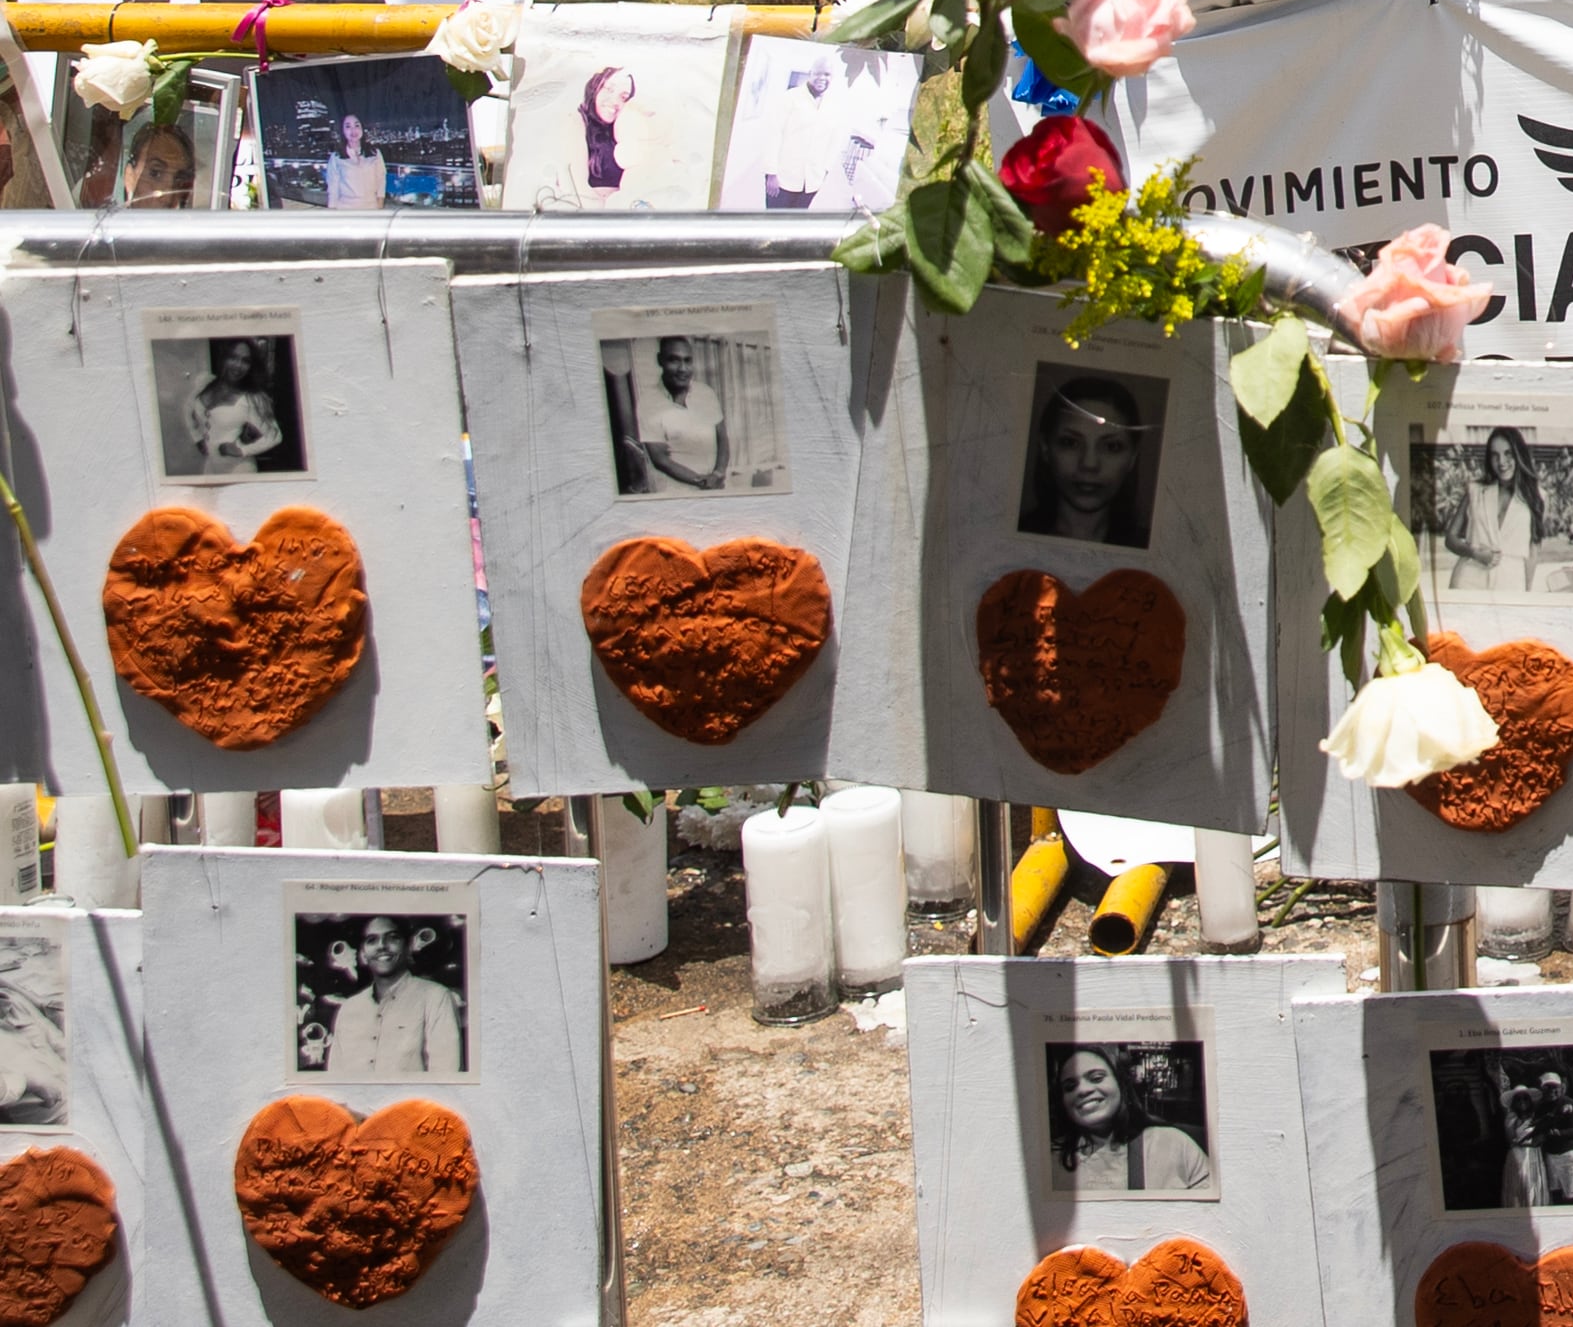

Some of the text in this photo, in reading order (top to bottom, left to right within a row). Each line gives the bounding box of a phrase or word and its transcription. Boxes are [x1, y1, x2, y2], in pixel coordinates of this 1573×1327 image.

[1180, 154, 1499, 218] OVIMIENTO
[1093, 1014, 1114, 1022] Paola
[1115, 1013, 1135, 1022] Vidal
[1136, 1013, 1172, 1022] Perdomo
